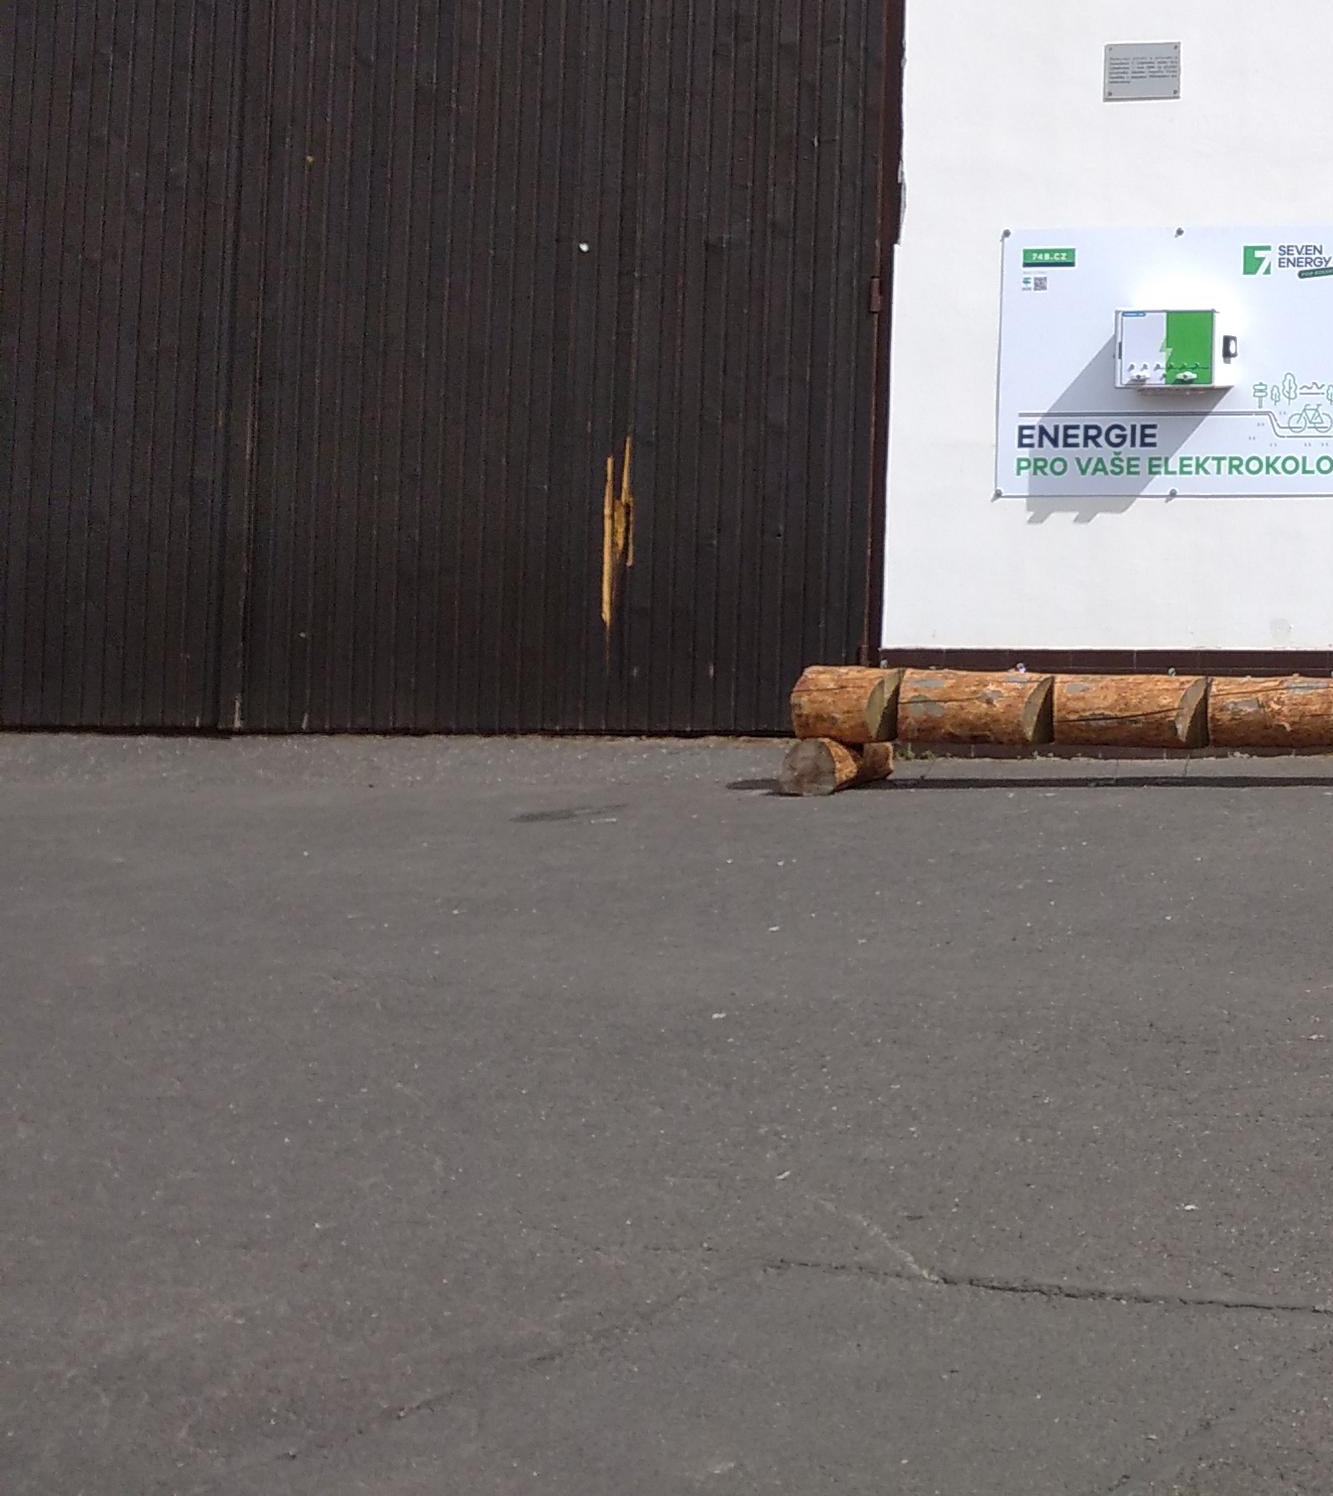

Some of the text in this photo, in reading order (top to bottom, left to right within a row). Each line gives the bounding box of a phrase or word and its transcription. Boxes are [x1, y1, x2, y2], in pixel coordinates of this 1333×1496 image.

[1278, 256, 1332, 268] ENERGY
[1017, 423, 1158, 448] ENERGIE
[1016, 456, 1068, 476] PRO
[1075, 451, 1141, 476] VAŠE
